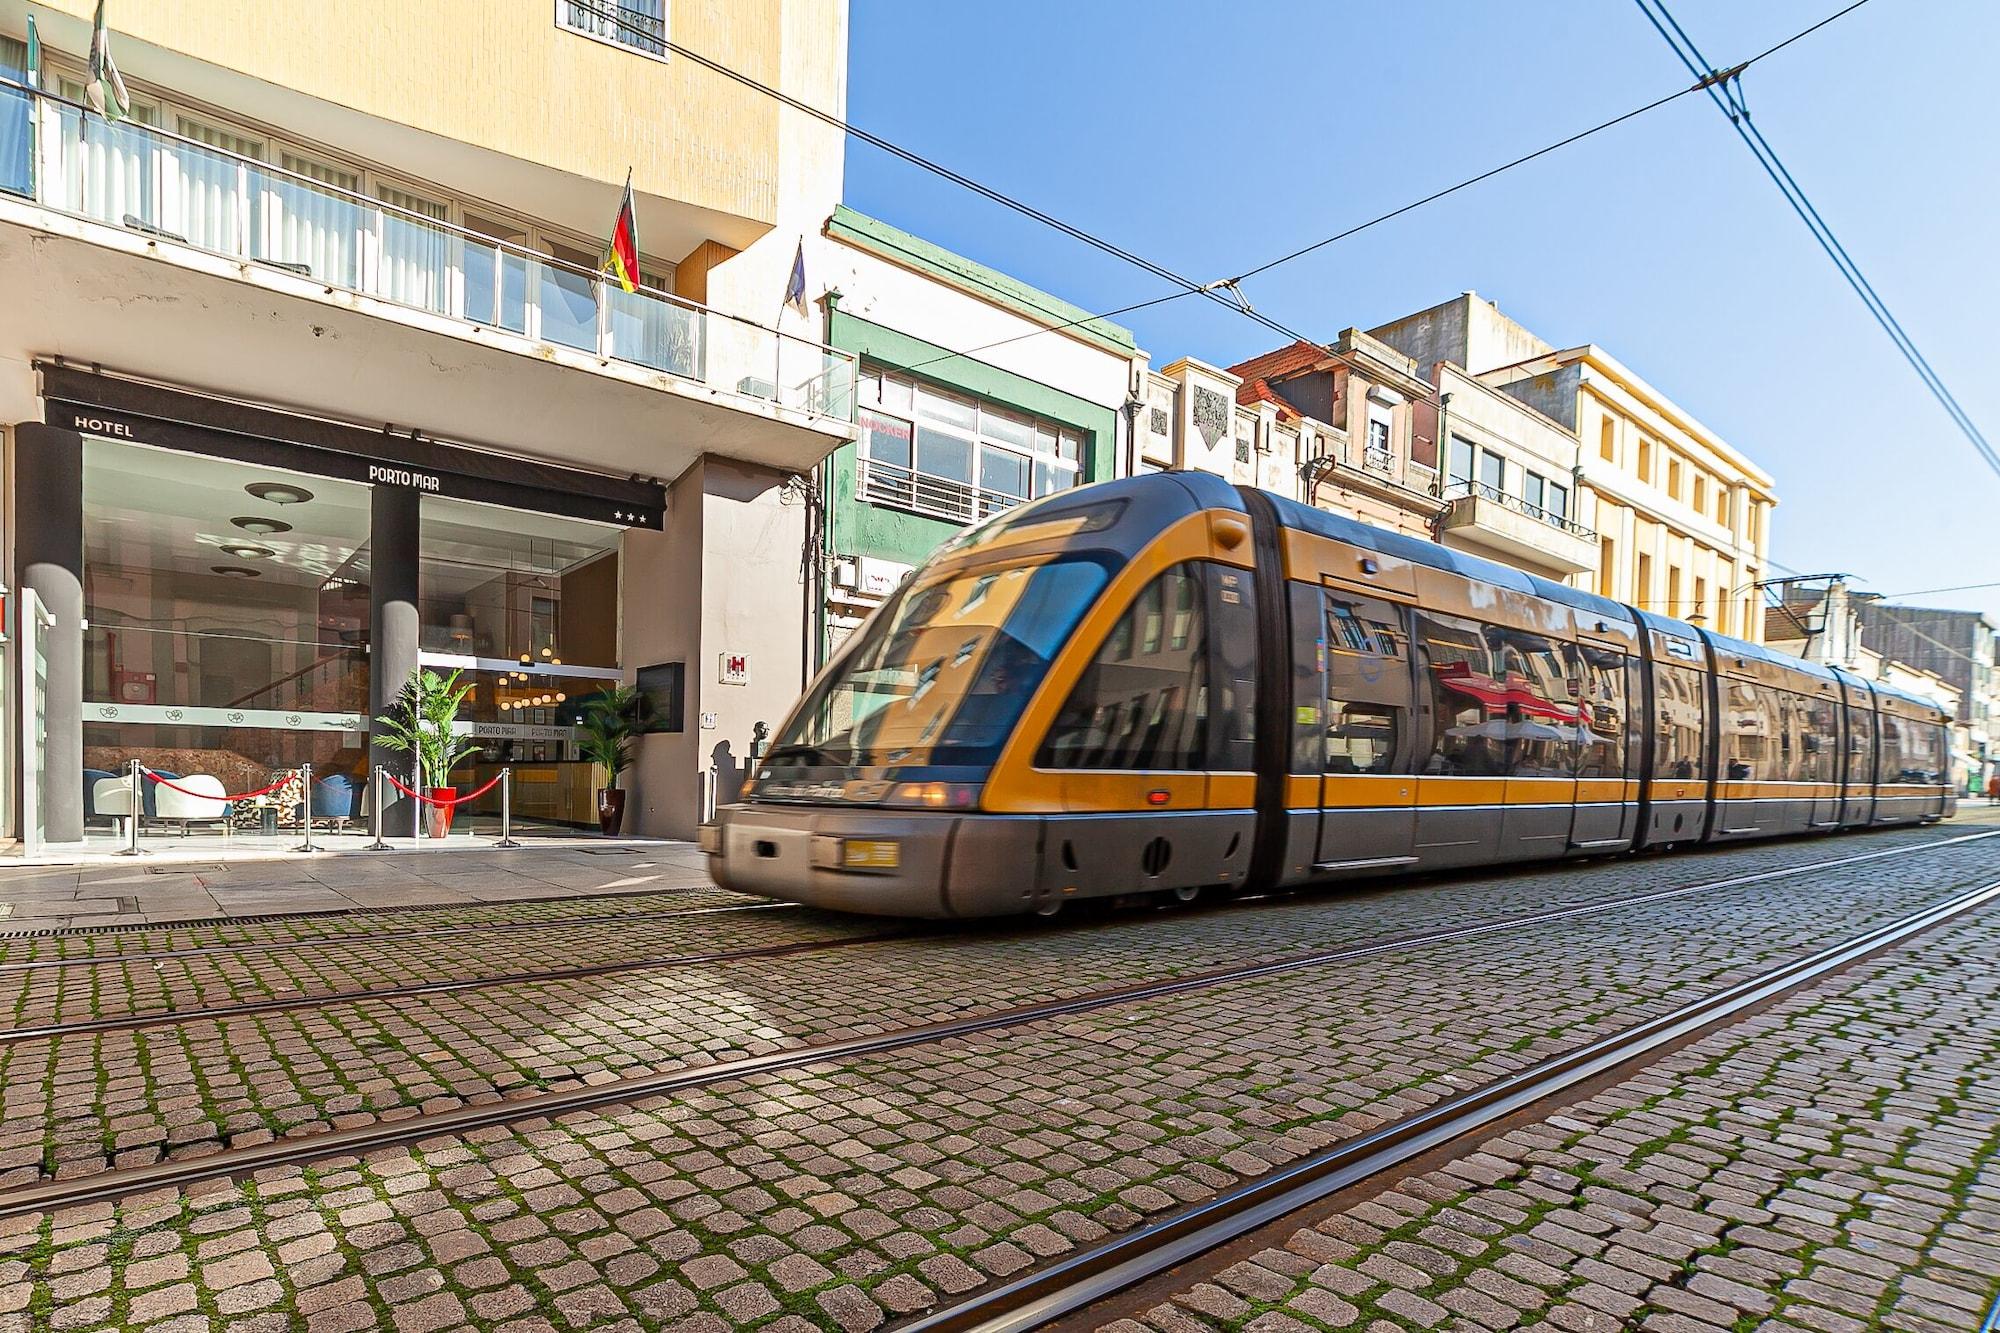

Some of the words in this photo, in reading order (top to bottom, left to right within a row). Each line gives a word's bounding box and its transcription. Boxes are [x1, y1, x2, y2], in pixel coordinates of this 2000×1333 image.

[75, 416, 134, 437] HOTEL
[369, 465, 410, 486] PORTO
[412, 473, 440, 491] MAR
[732, 656, 745, 672] H
